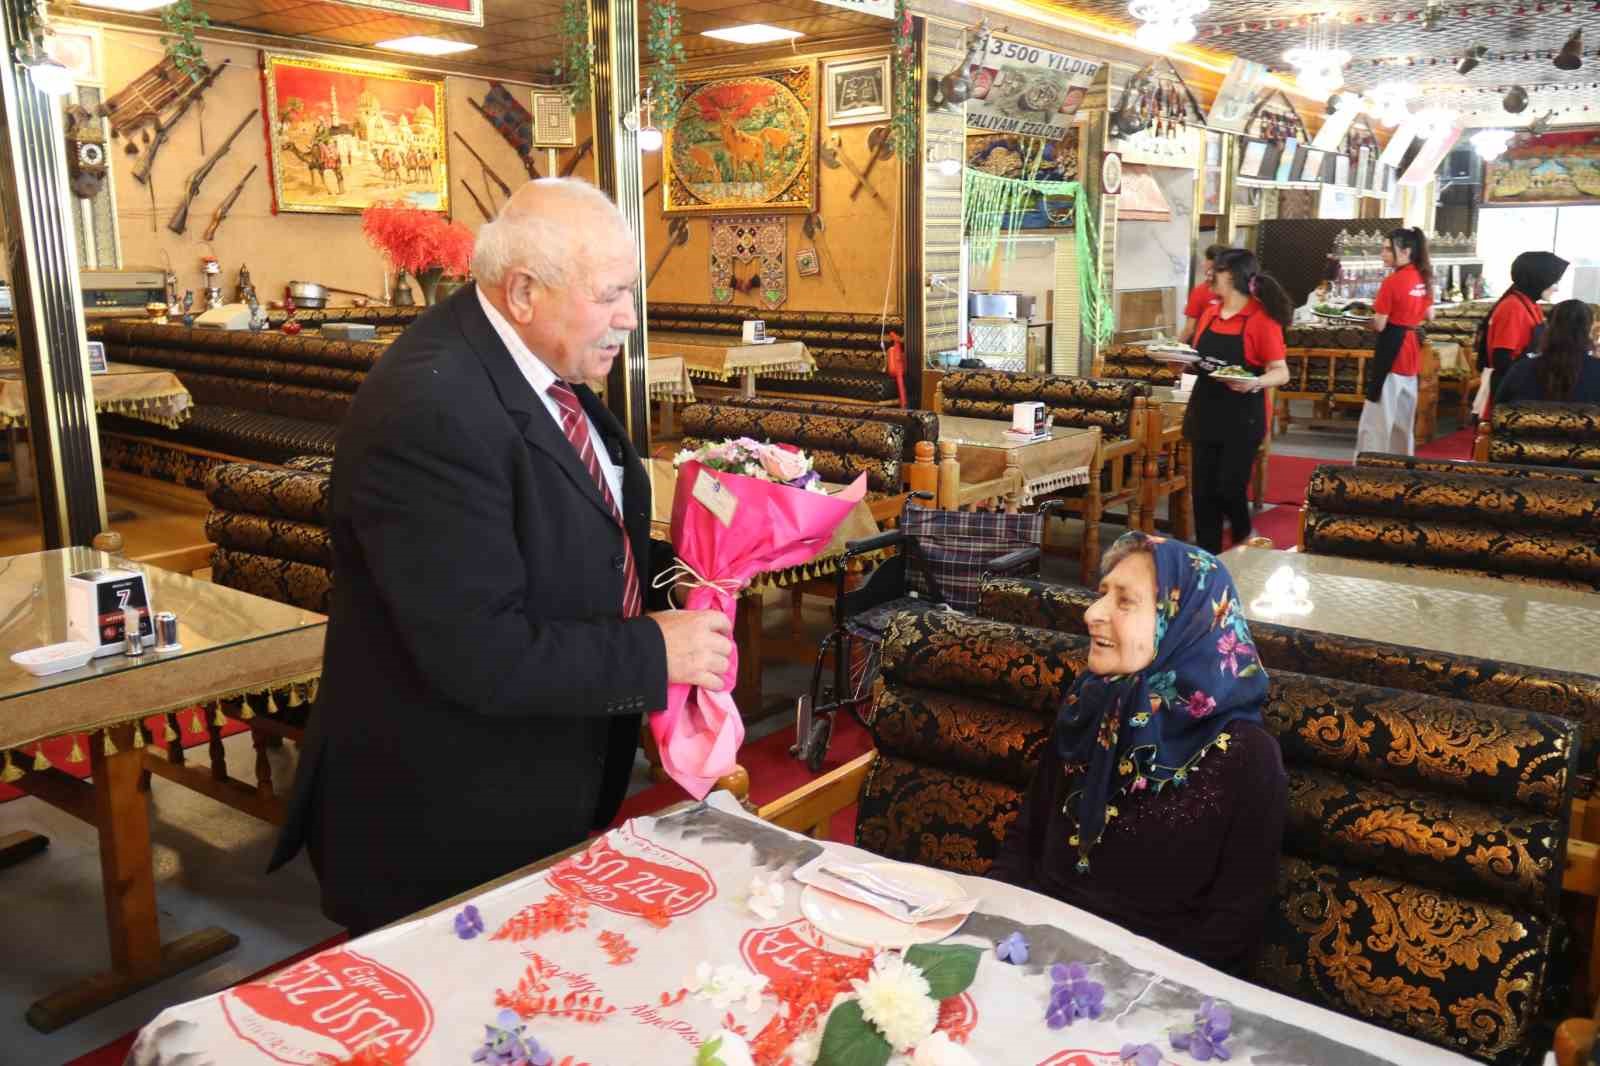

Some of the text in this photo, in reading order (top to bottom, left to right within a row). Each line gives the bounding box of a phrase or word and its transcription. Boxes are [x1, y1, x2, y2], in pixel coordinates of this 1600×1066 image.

[1047, 54, 1098, 77] YILDIR
[966, 113, 1018, 131] FALIYAM
[116, 588, 131, 610] 7
[312, 991, 414, 1055] USTA
